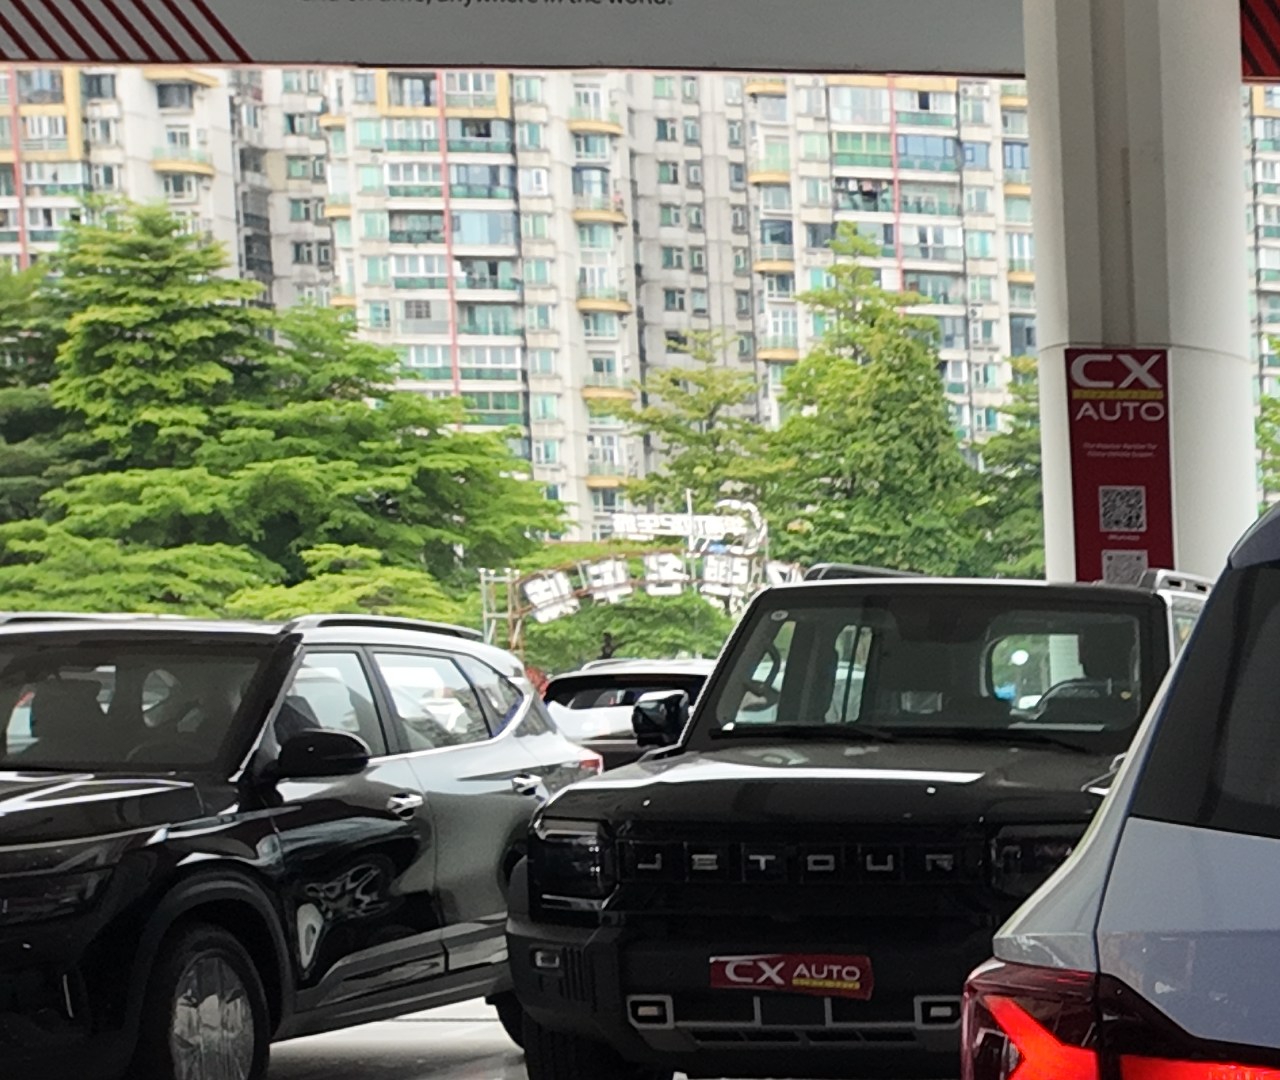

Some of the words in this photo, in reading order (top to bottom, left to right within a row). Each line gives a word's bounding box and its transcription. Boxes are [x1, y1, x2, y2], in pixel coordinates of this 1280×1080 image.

[1071, 353, 1162, 389] CX
[1075, 401, 1165, 422] AUTO
[637, 854, 954, 872] JETOUR
[725, 961, 786, 985] CX
[793, 964, 861, 980] AUTO
